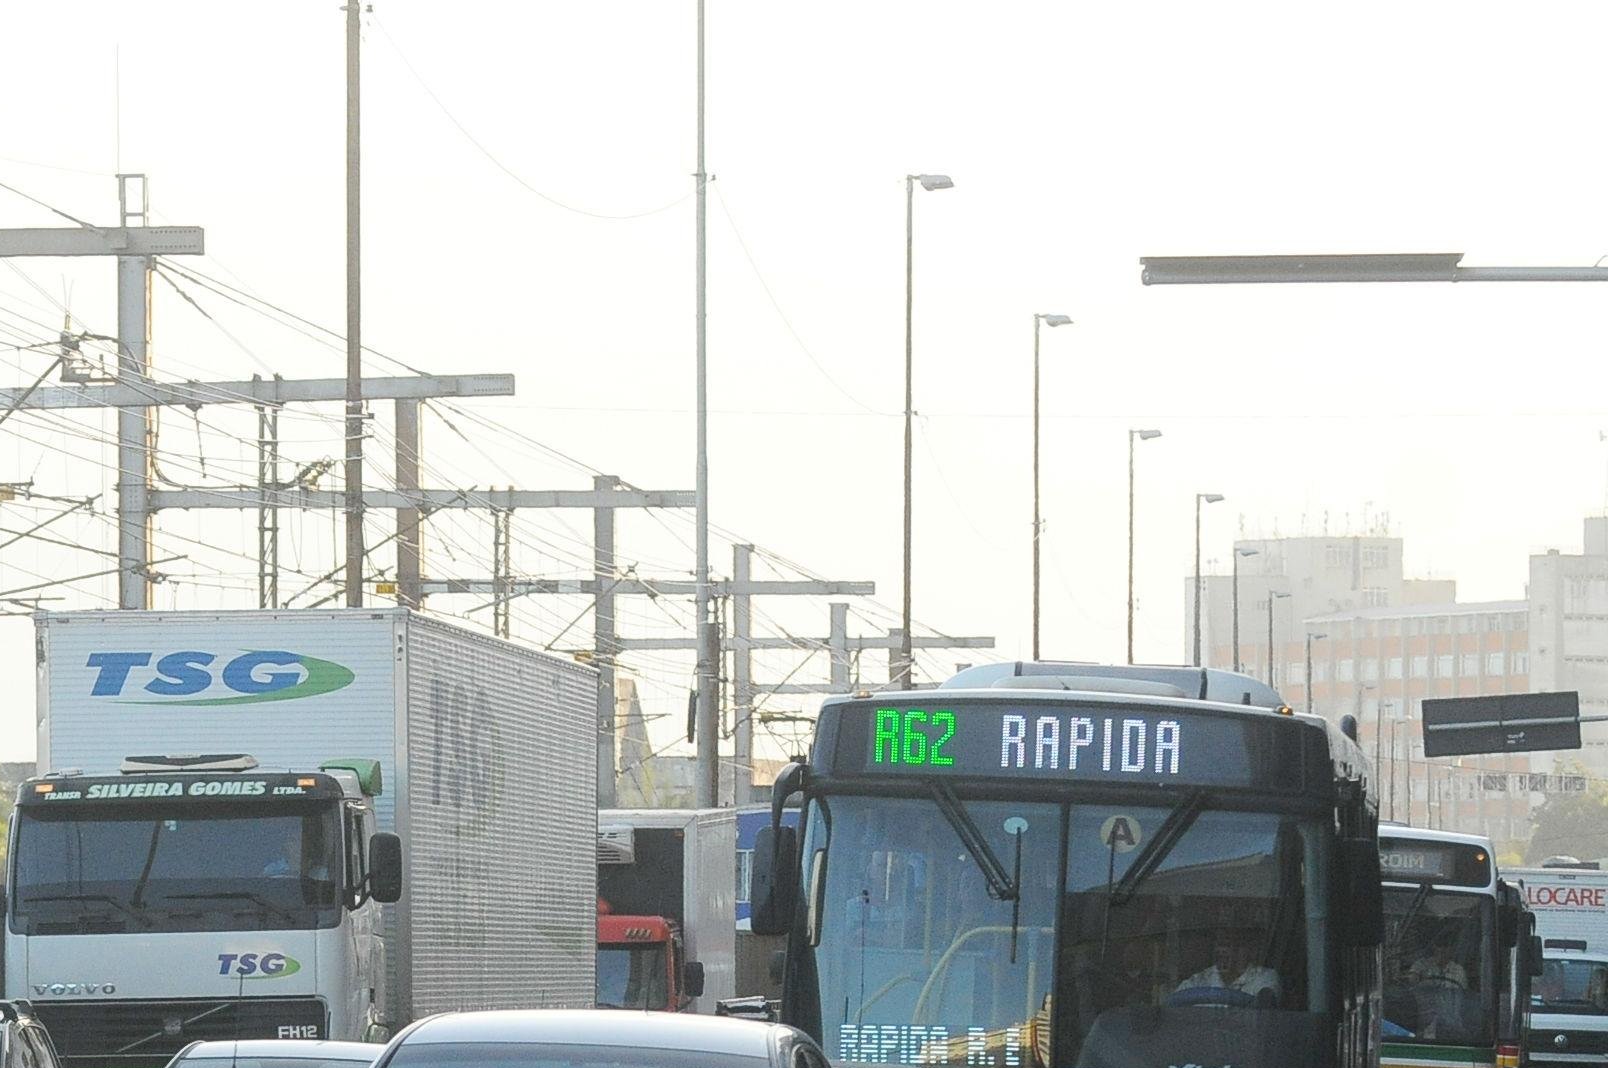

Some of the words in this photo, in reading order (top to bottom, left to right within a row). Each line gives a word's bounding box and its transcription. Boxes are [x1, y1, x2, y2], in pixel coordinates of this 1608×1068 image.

[86, 651, 309, 696] TSG
[1000, 714, 1180, 774] RAPIDA
[86, 782, 184, 799] SILVEIRA
[188, 781, 267, 797] GOMES
[272, 786, 306, 795] LTDA.
[1105, 817, 1135, 846] A
[218, 952, 285, 976] TSG
[33, 982, 116, 996] VOLVO
[278, 1025, 317, 1039] FH12
[840, 1024, 948, 1064] RAPIDA
